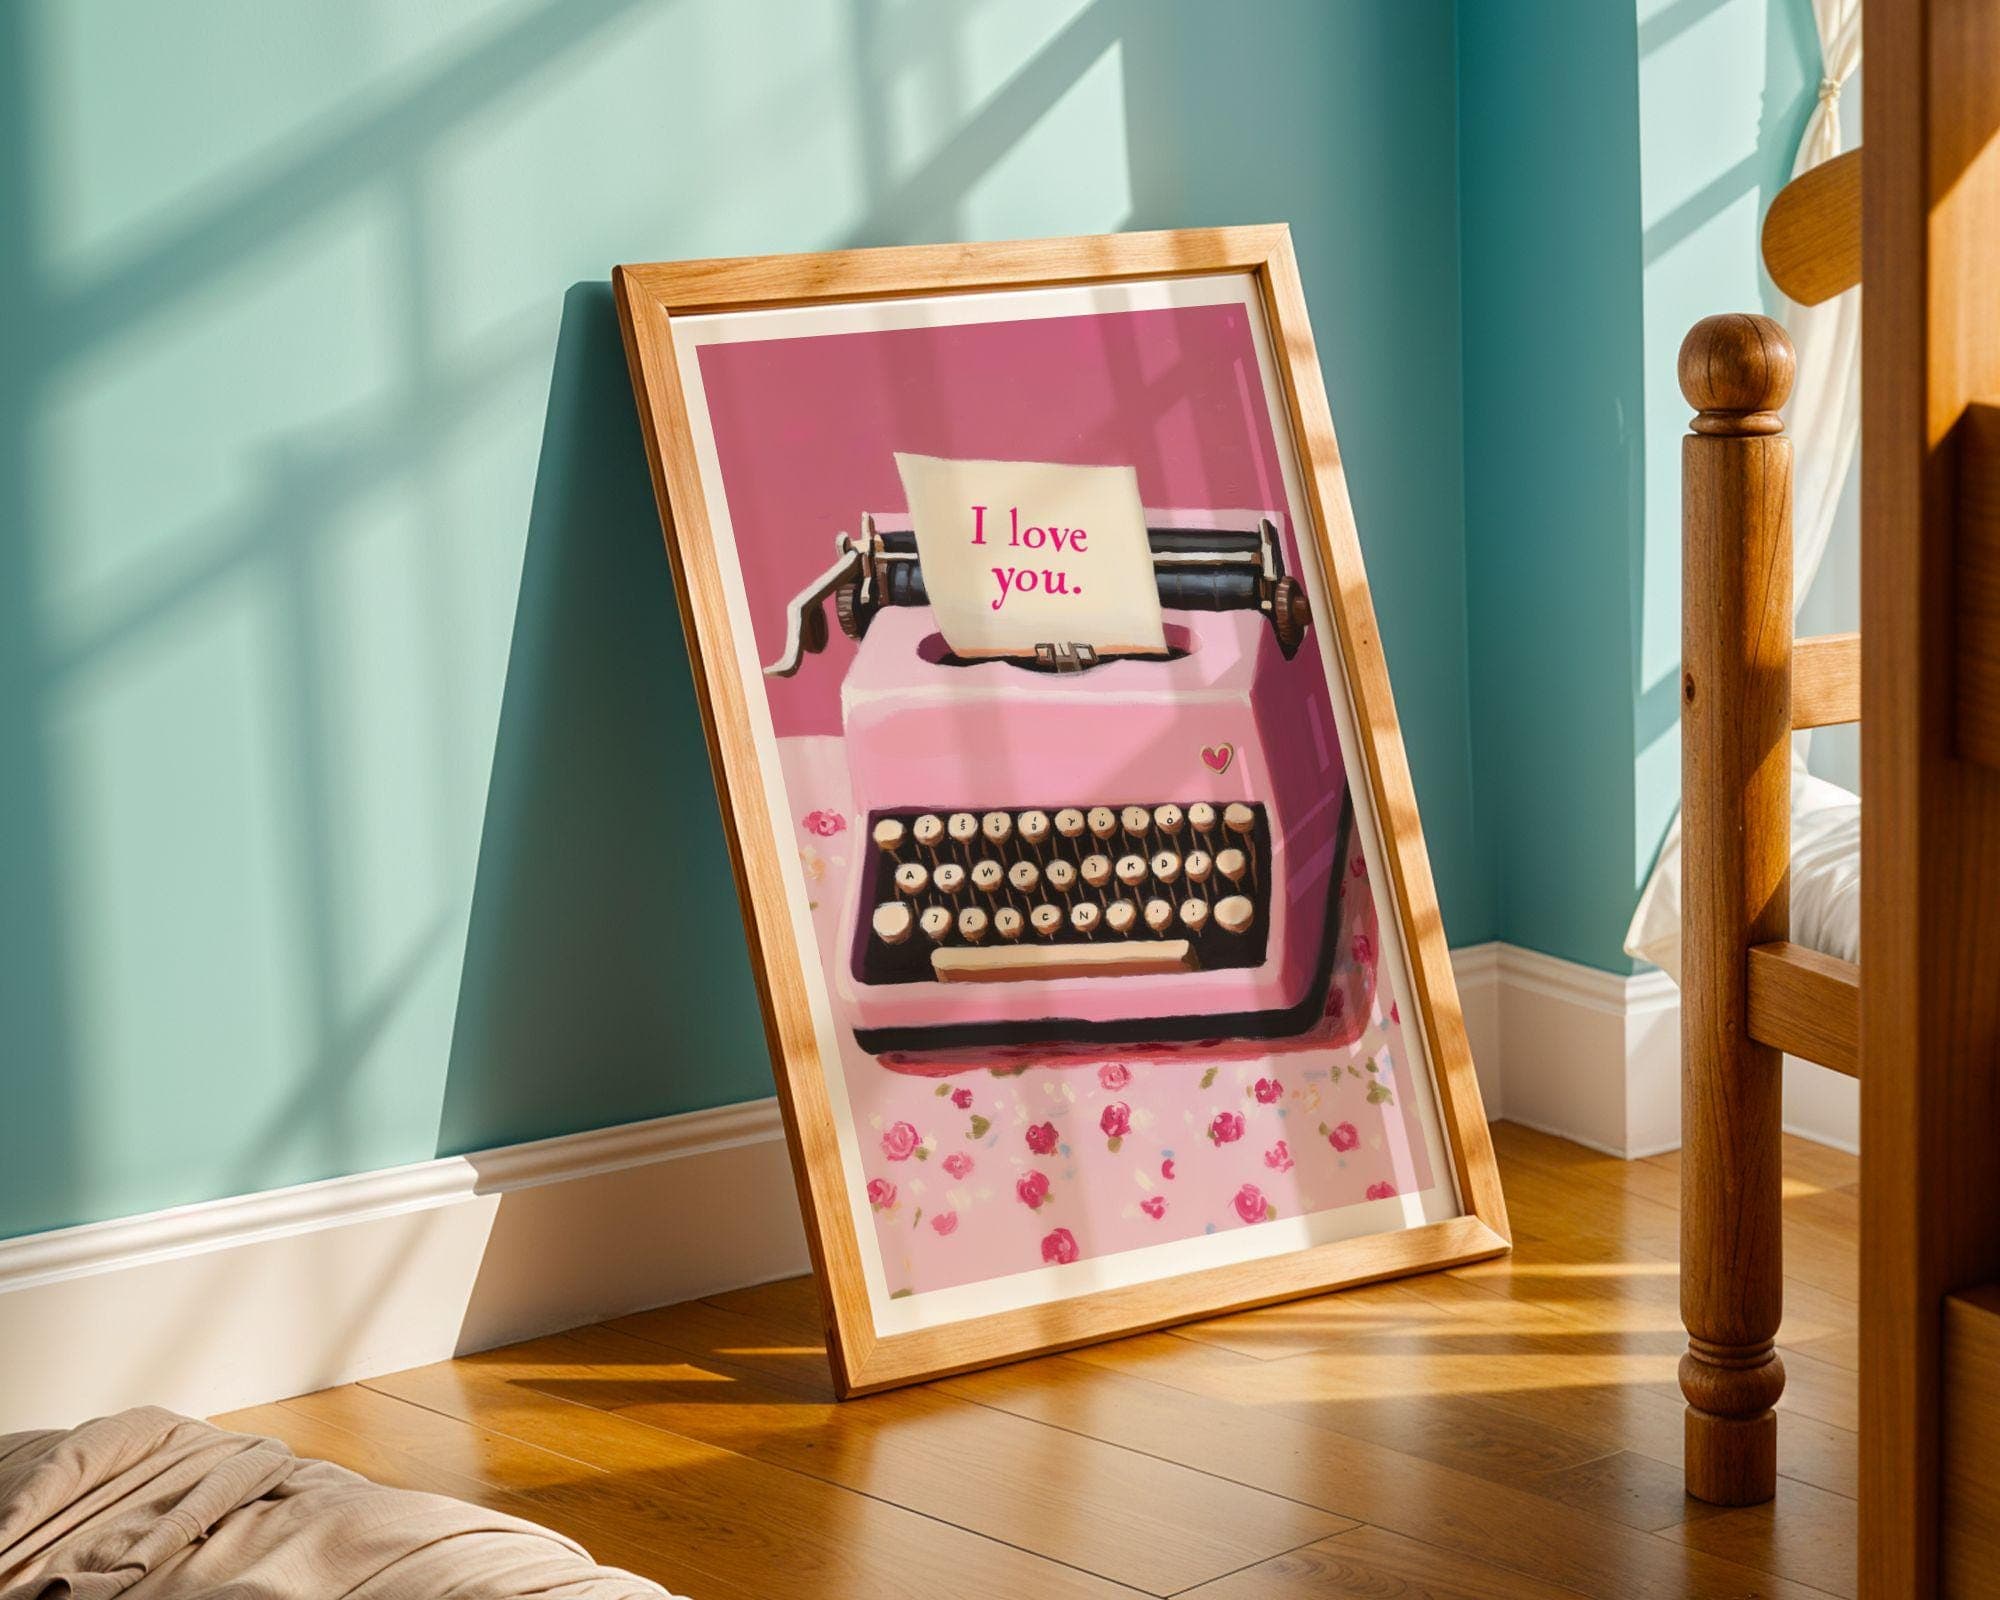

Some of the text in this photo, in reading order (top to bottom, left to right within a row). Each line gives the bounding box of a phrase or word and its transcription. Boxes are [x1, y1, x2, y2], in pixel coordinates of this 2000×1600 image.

[971, 506, 1088, 553] I love
[991, 567, 1082, 610] you.
